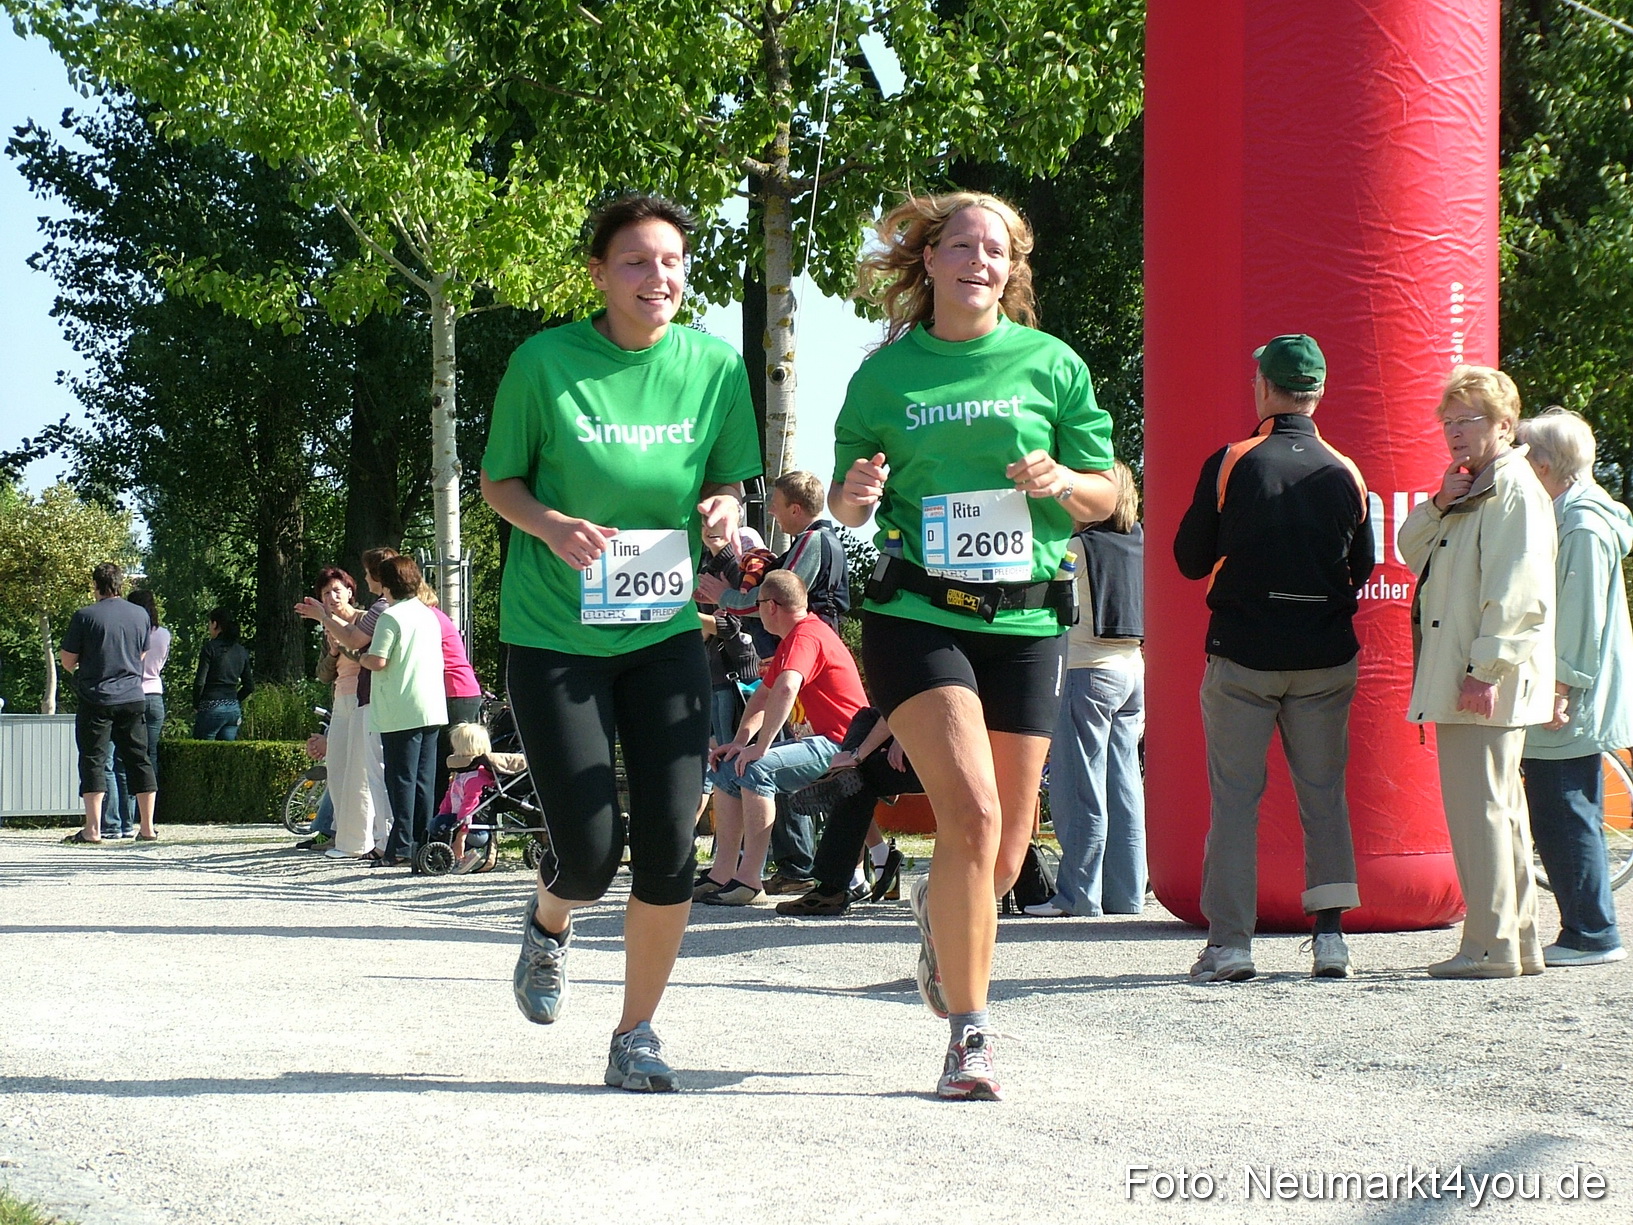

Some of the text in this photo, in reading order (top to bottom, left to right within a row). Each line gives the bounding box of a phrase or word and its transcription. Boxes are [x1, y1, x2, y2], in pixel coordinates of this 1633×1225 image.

[905, 394, 1024, 430] Sinupret
[576, 415, 695, 452] Sinupret
[953, 502, 981, 518] Rita
[927, 530, 935, 542] D
[957, 530, 1024, 557] 2608
[611, 539, 640, 556] Tina
[585, 567, 592, 580] D
[615, 571, 684, 597] 2609
